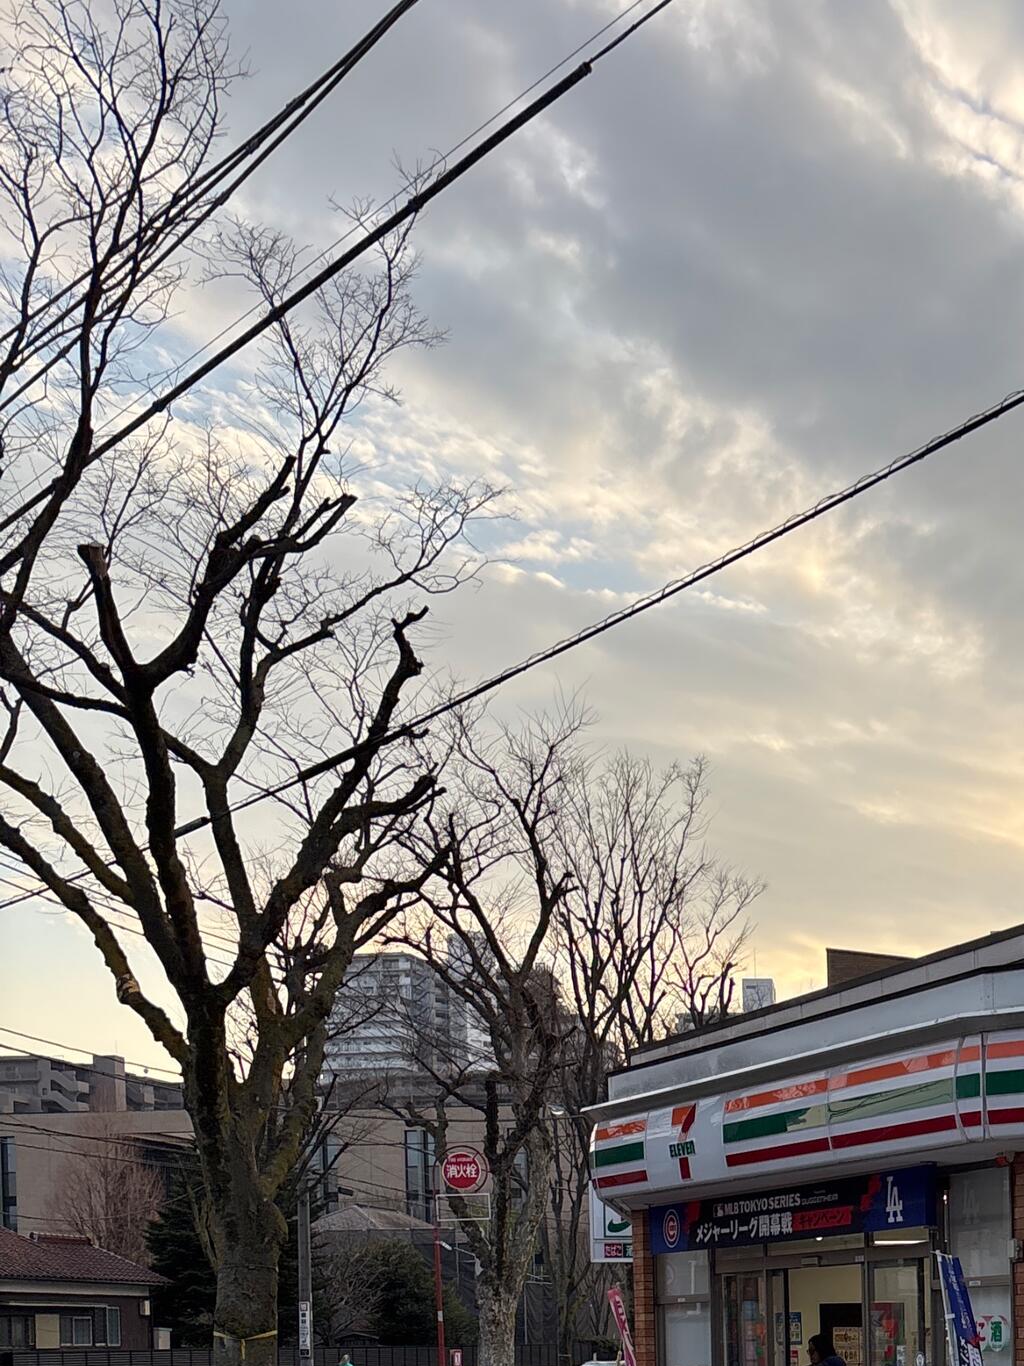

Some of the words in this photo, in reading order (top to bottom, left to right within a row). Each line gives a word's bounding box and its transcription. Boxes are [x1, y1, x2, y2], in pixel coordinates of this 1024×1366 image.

[672, 1103, 697, 1180] 7
[446, 1163, 478, 1178] 消火栓
[724, 1201, 739, 1216] MLB
[738, 1197, 769, 1214] TOKYO
[768, 1193, 801, 1209] SERIES
[886, 1176, 904, 1223] LA
[695, 1211, 793, 1243] メジャーリーグ開幕戦
[605, 1244, 622, 1257] たばこ
[991, 1320, 1002, 1343] 酒
